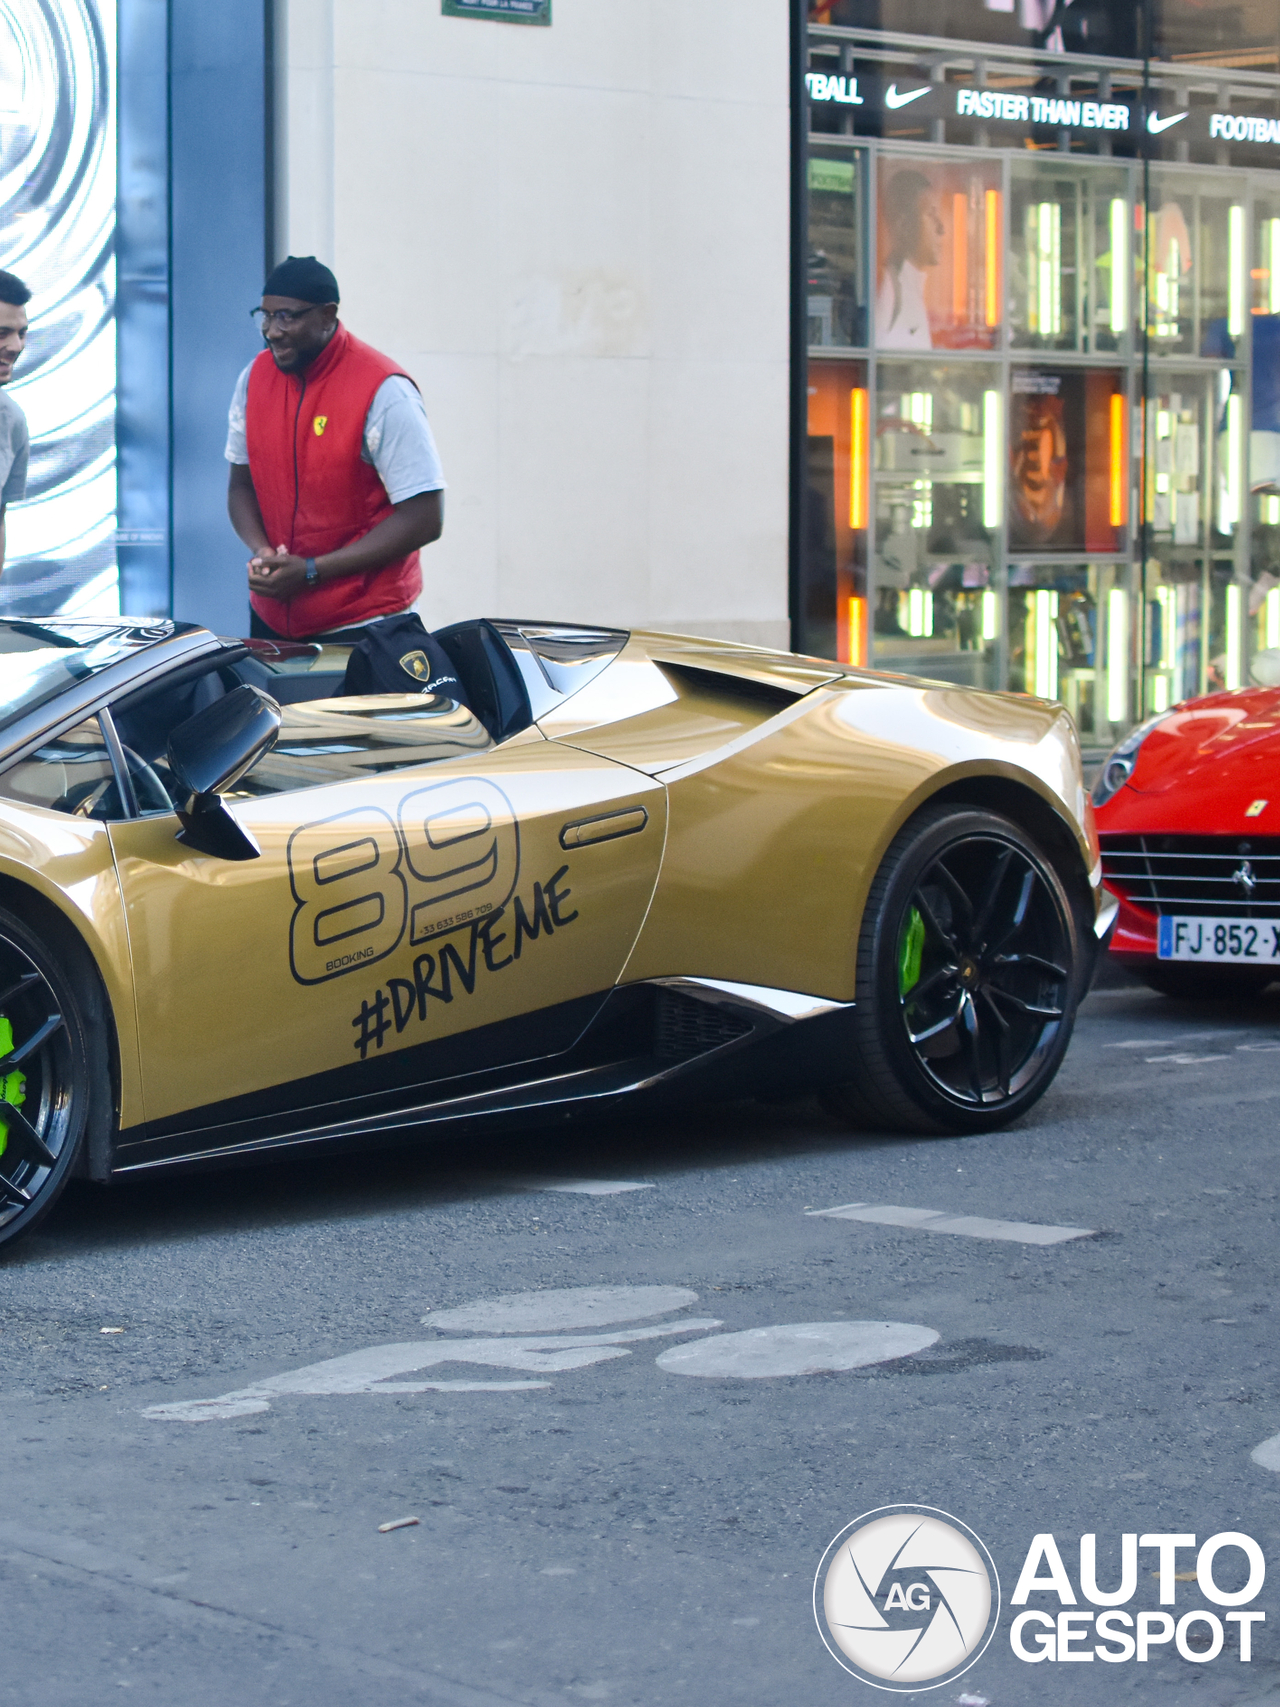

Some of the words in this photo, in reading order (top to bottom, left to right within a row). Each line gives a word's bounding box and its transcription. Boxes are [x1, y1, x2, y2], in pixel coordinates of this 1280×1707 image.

[956, 89, 1029, 121] FASTER
[1030, 97, 1081, 126] THAN
[1081, 102, 1130, 130] EVER
[286, 776, 520, 986] 89
[436, 917, 454, 930] 633
[475, 902, 493, 915] 709
[326, 947, 374, 971] BOOKING
